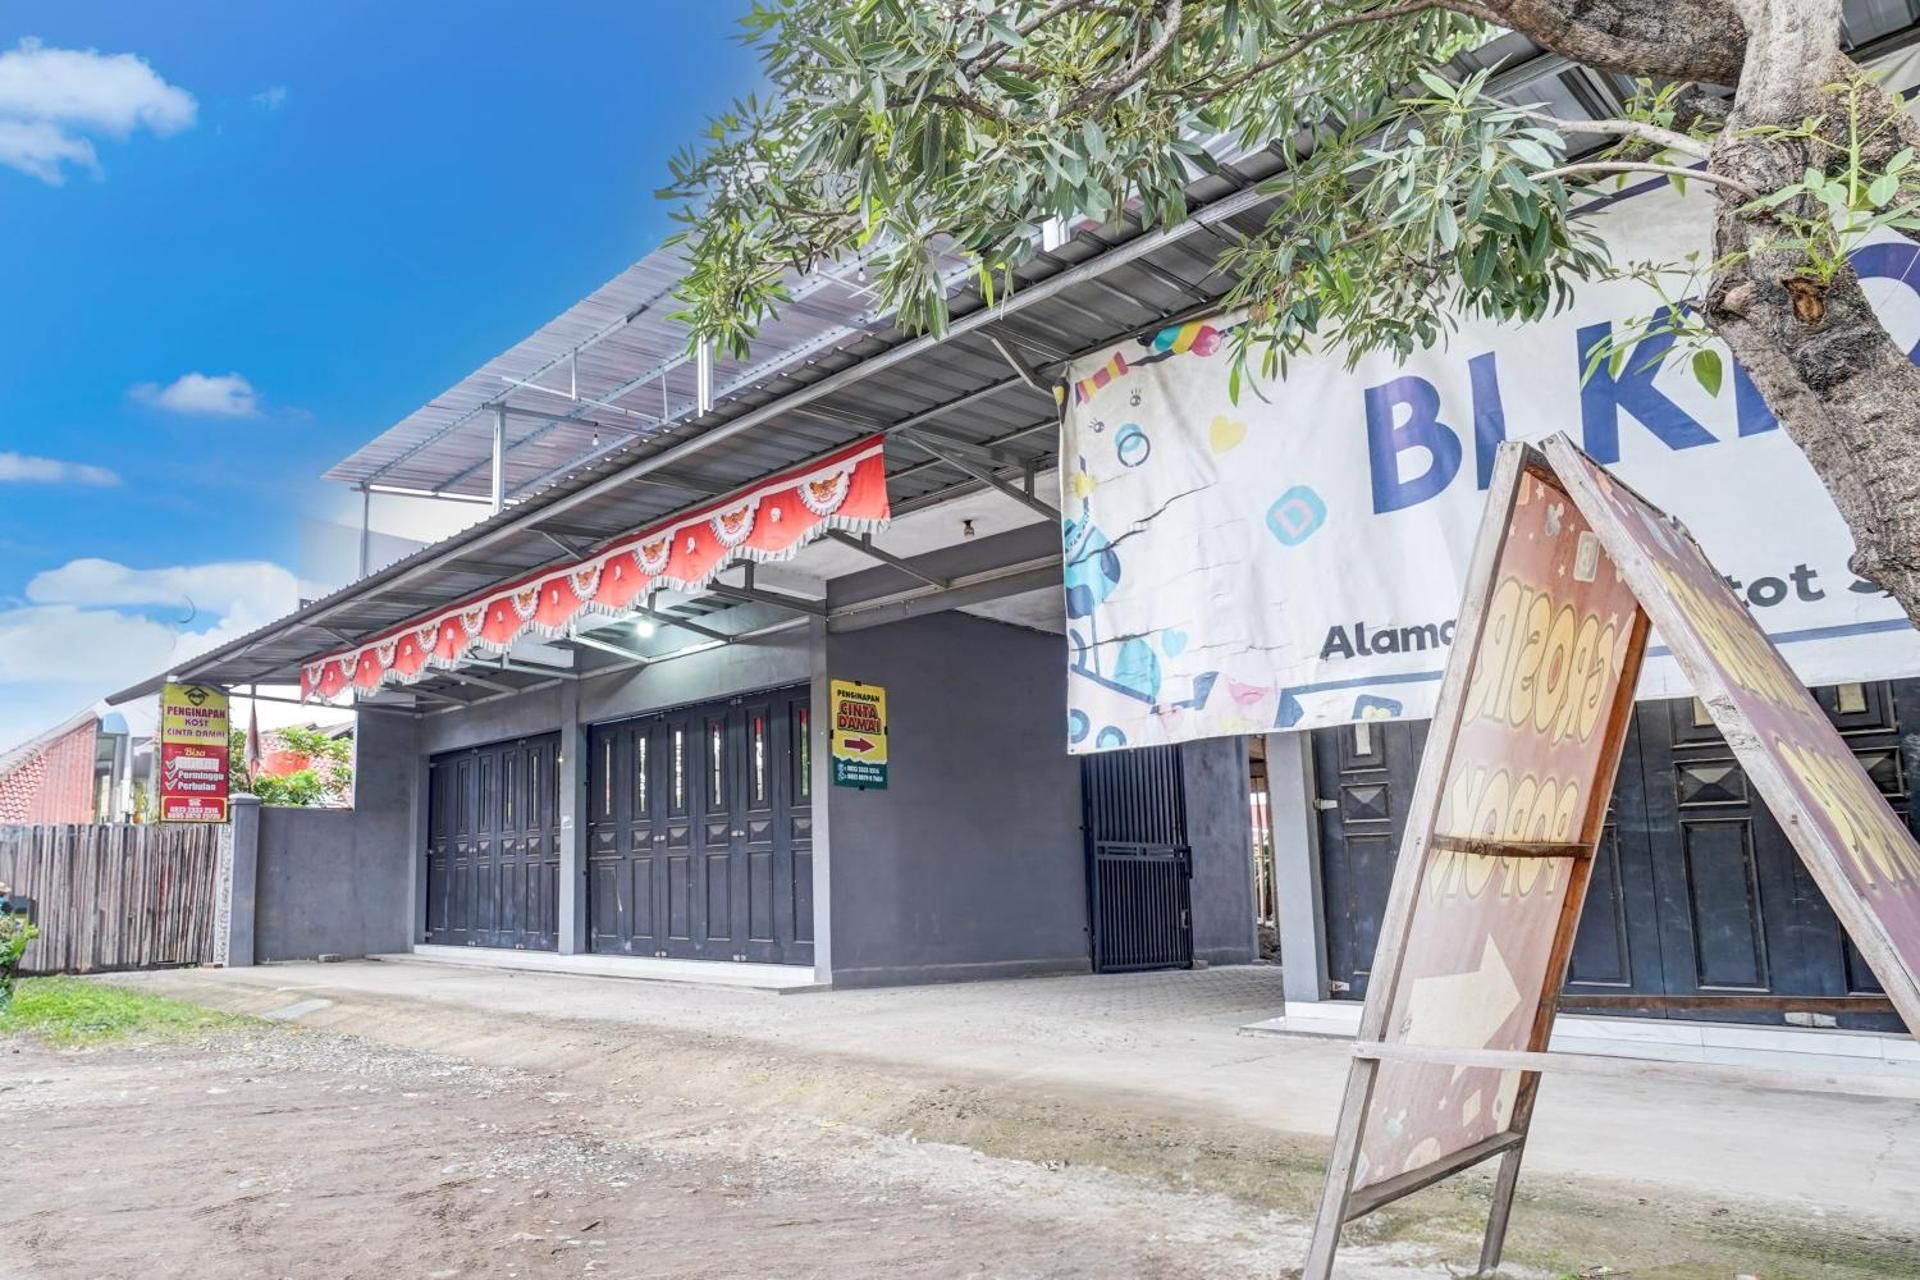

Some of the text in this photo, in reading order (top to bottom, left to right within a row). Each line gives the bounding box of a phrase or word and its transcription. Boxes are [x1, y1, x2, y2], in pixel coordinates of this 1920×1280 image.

[837, 689, 880, 702] PENGINAPAN
[167, 706, 226, 719] PENGINAPAN
[840, 701, 879, 719] CINTA
[185, 718, 208, 727] KOST
[838, 714, 882, 734] DAMAI
[167, 728, 225, 738] CINTA DAMAI
